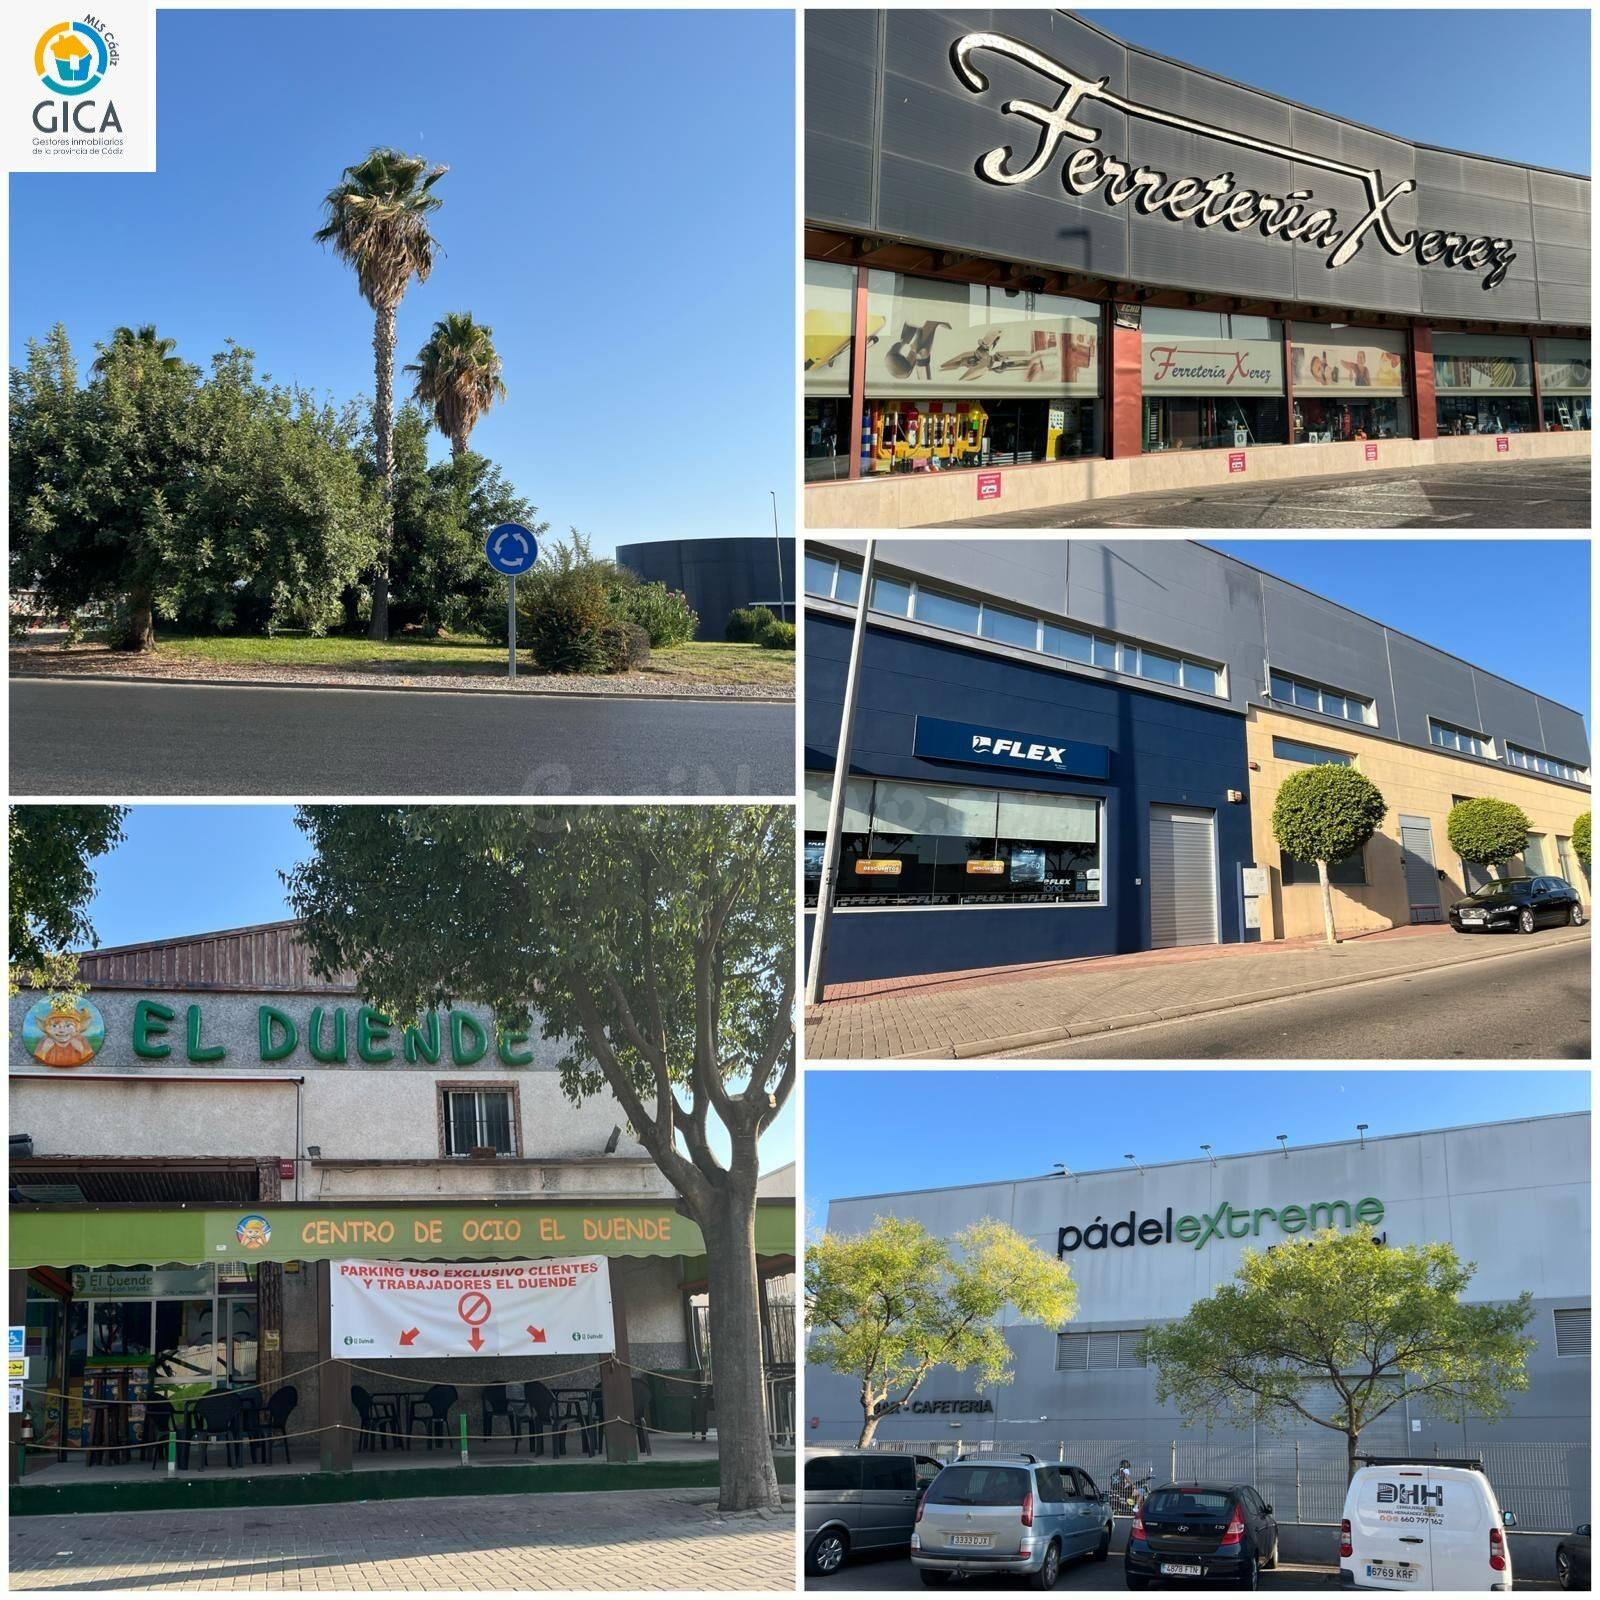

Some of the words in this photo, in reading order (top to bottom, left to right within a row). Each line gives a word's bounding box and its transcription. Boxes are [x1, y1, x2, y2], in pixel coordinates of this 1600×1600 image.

[949, 31, 1342, 249] Ferretería
[1326, 168, 1517, 291] Xerez
[1149, 346, 1226, 381] Ferretería
[1226, 351, 1271, 385] Xerez
[992, 739, 1067, 764] FLEX
[916, 895, 951, 904] FLEX
[133, 1000, 227, 1063] EL
[258, 1004, 535, 1067] DUENDE
[302, 1219, 396, 1246] CENTRO
[414, 1219, 443, 1244] DE
[462, 1217, 521, 1242] OCIO
[539, 1217, 567, 1242] EL
[582, 1216, 672, 1241] DUENDE
[90, 1275, 101, 1287] El
[106, 1274, 153, 1287] Duende
[341, 1265, 405, 1278] PARKING
[409, 1267, 439, 1278] USO
[443, 1267, 524, 1278] EXCLUSIVO
[528, 1262, 599, 1276] CLIENTES
[363, 1278, 374, 1290] Y
[377, 1278, 492, 1291] TRABAJADORES
[496, 1277, 514, 1290] EL
[518, 1276, 578, 1289] DUENDE
[1376, 1482, 1444, 1507] DHH
[1371, 1566, 1395, 1578] 6769
[1396, 1568, 1414, 1580] KRF
